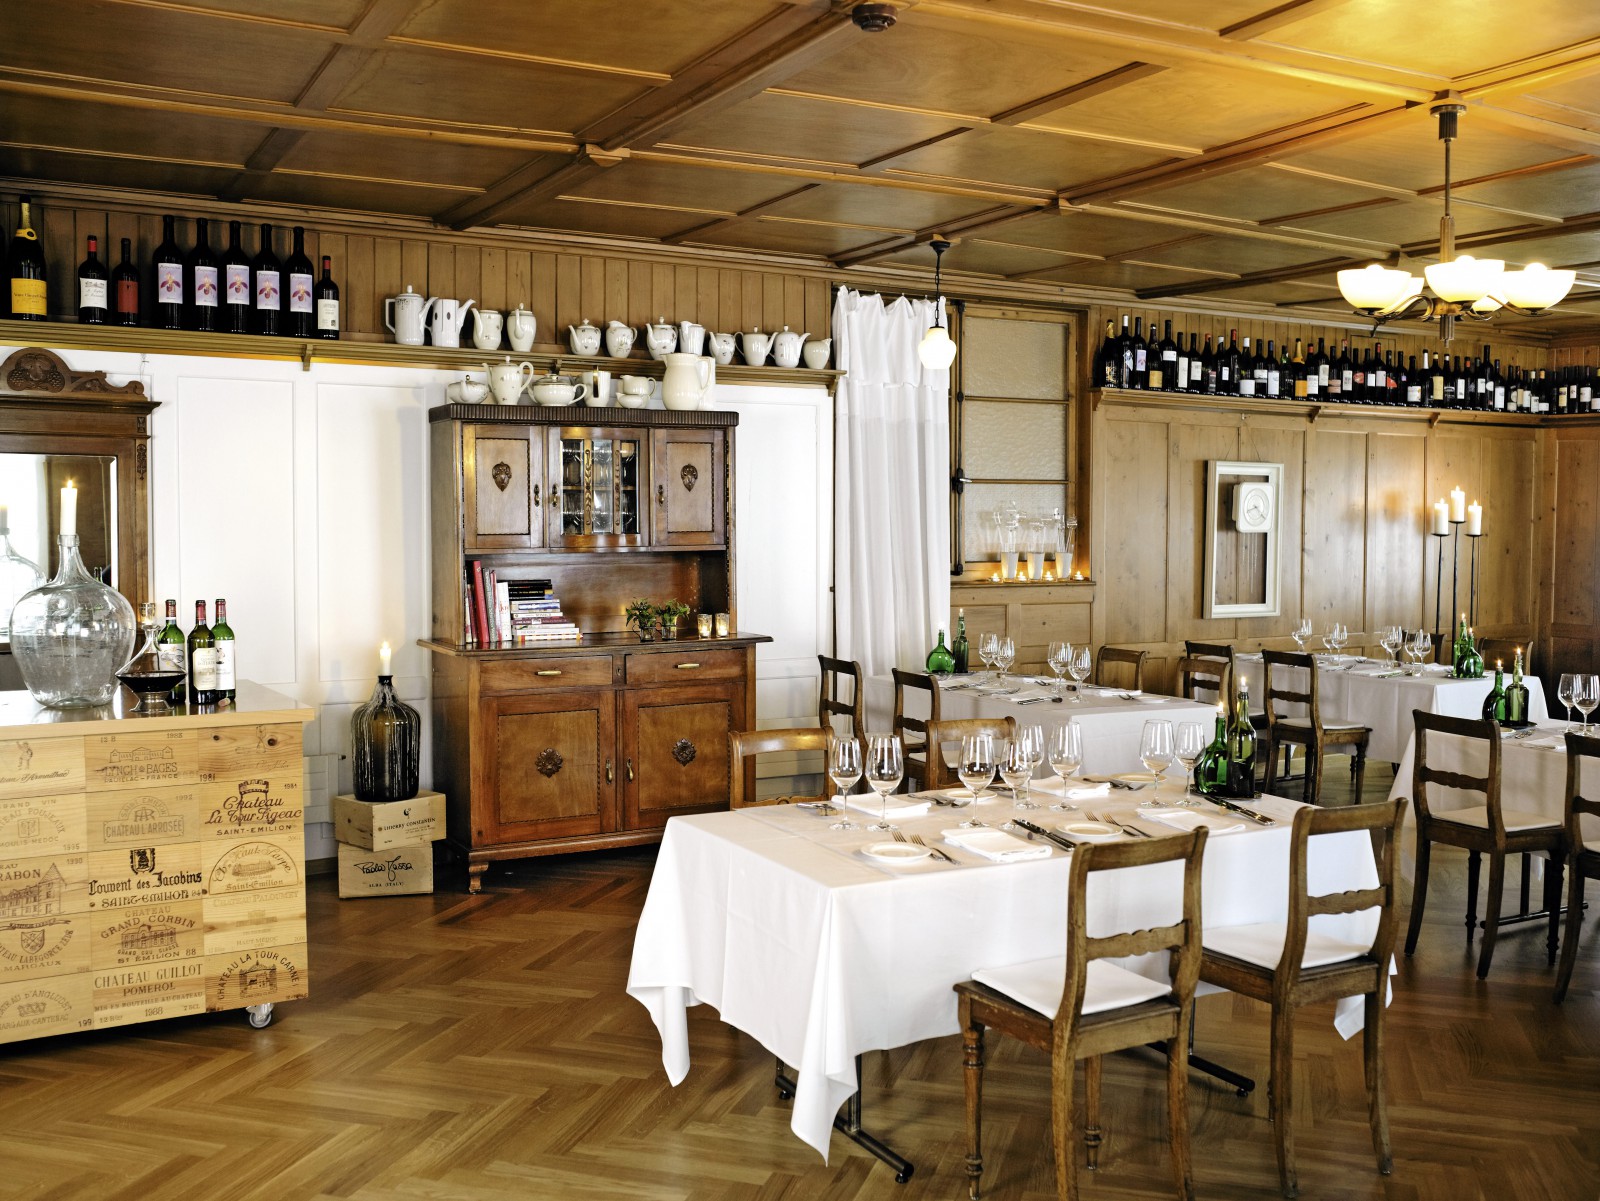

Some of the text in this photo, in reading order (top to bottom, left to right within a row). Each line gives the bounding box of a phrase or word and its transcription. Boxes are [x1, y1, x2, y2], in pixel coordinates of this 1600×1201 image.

[146, 762, 178, 774] BAGES
[204, 809, 223, 824] La
[256, 807, 302, 825] Figeac
[216, 824, 292, 836] SAINT-EMILION
[136, 879, 151, 890] des
[152, 870, 202, 888] Jacobins
[124, 906, 171, 918] CHATEAU
[100, 915, 196, 939] GRAND CORBIN
[239, 953, 252, 964] LA
[254, 950, 279, 961] TOUR
[94, 963, 203, 989] CHATEAU GUILLOT
[123, 981, 176, 997] POMEROL
